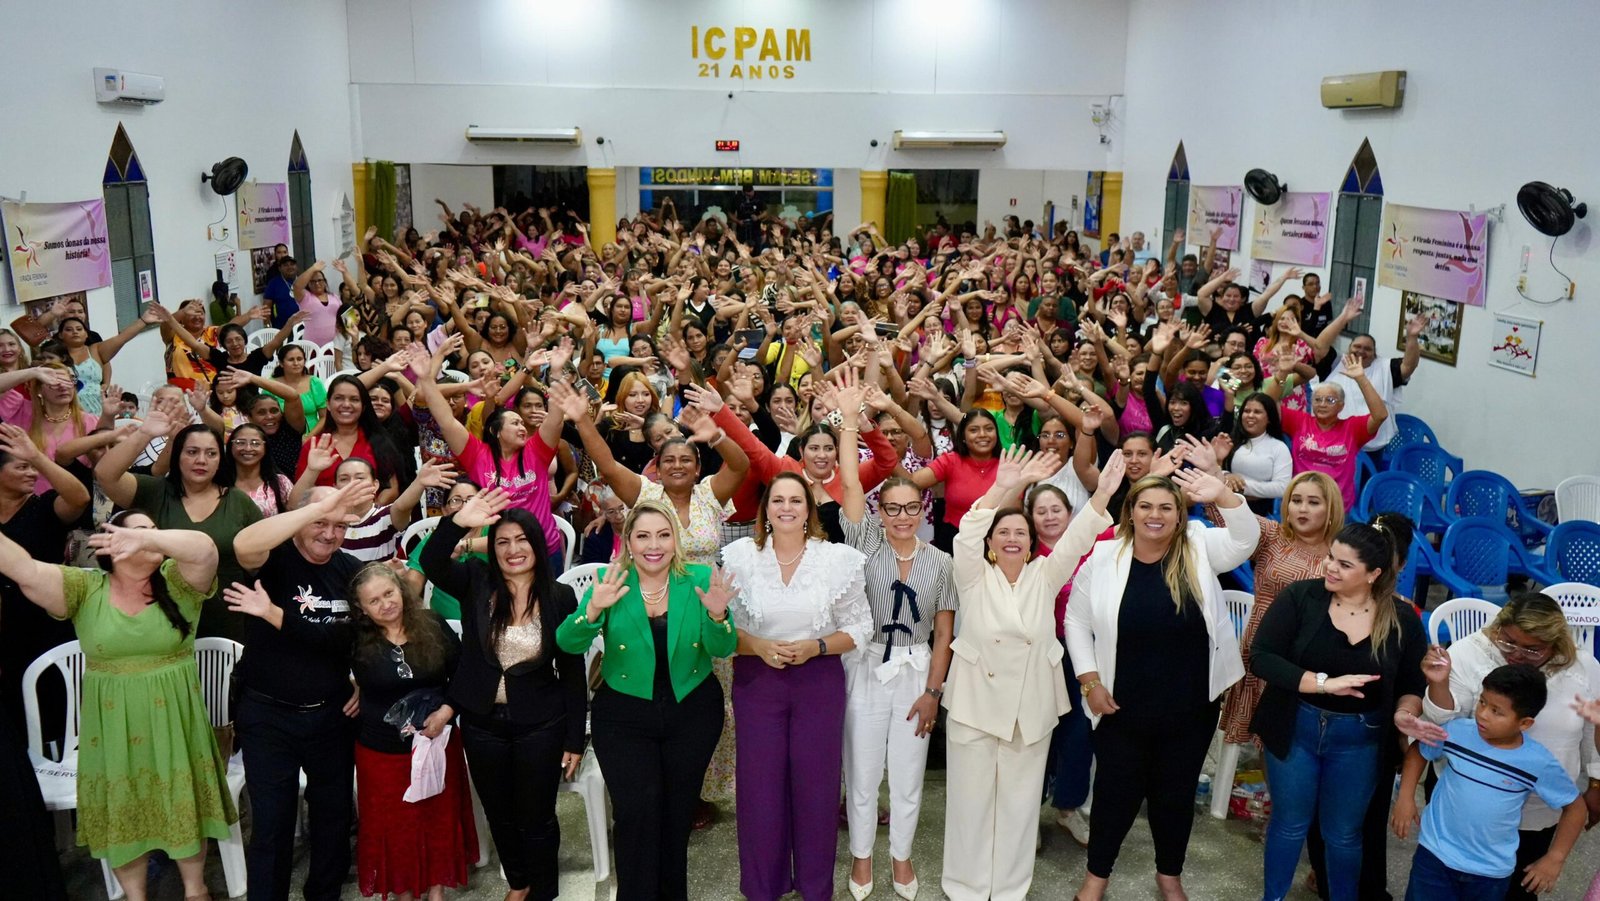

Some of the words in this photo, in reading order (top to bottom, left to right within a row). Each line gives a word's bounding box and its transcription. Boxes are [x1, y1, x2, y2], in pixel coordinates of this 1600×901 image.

[691, 26, 811, 61] ICPAM
[698, 63, 719, 78] 21
[730, 64, 795, 79] ANOS
[44, 241, 65, 250] Somos
[65, 238, 82, 248] donas
[83, 236, 90, 245] da
[90, 236, 106, 245] nossa
[1432, 238, 1455, 248] Feminina
[65, 248, 91, 260] história!
